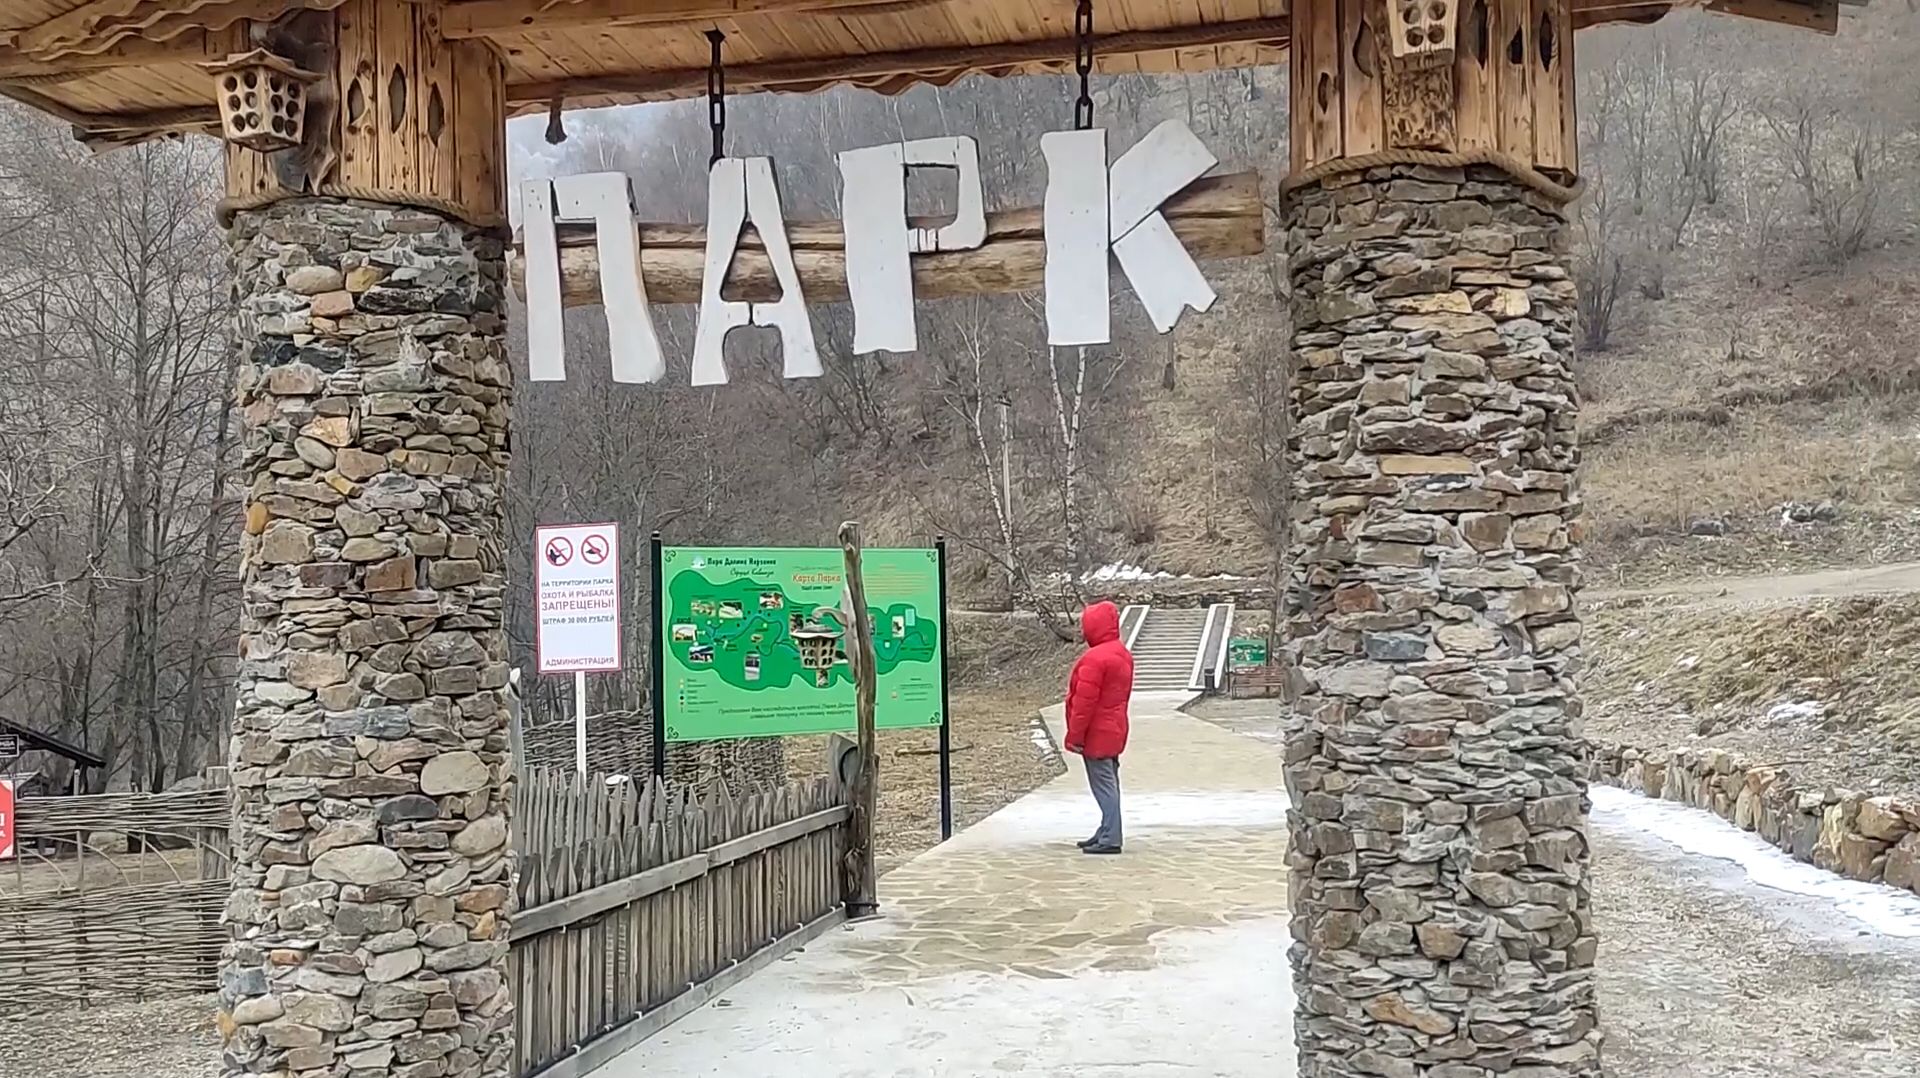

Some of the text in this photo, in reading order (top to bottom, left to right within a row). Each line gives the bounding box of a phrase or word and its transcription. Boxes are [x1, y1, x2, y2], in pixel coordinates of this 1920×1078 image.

[521, 118, 1218, 386] ПАРК
[551, 579, 592, 587] ТЕРРИТОРИИ
[792, 572, 841, 584] Карта Парка
[541, 589, 614, 599] ОХОТА И РЫБАЛКА
[541, 598, 614, 611] ЗАПРЕЩЕНЫ!
[542, 617, 567, 625] ШТРАФ
[576, 616, 588, 624] 000
[588, 614, 615, 624] РУБЛЕЙ
[546, 656, 614, 666] АДМИНИСТРАЦИЯ
